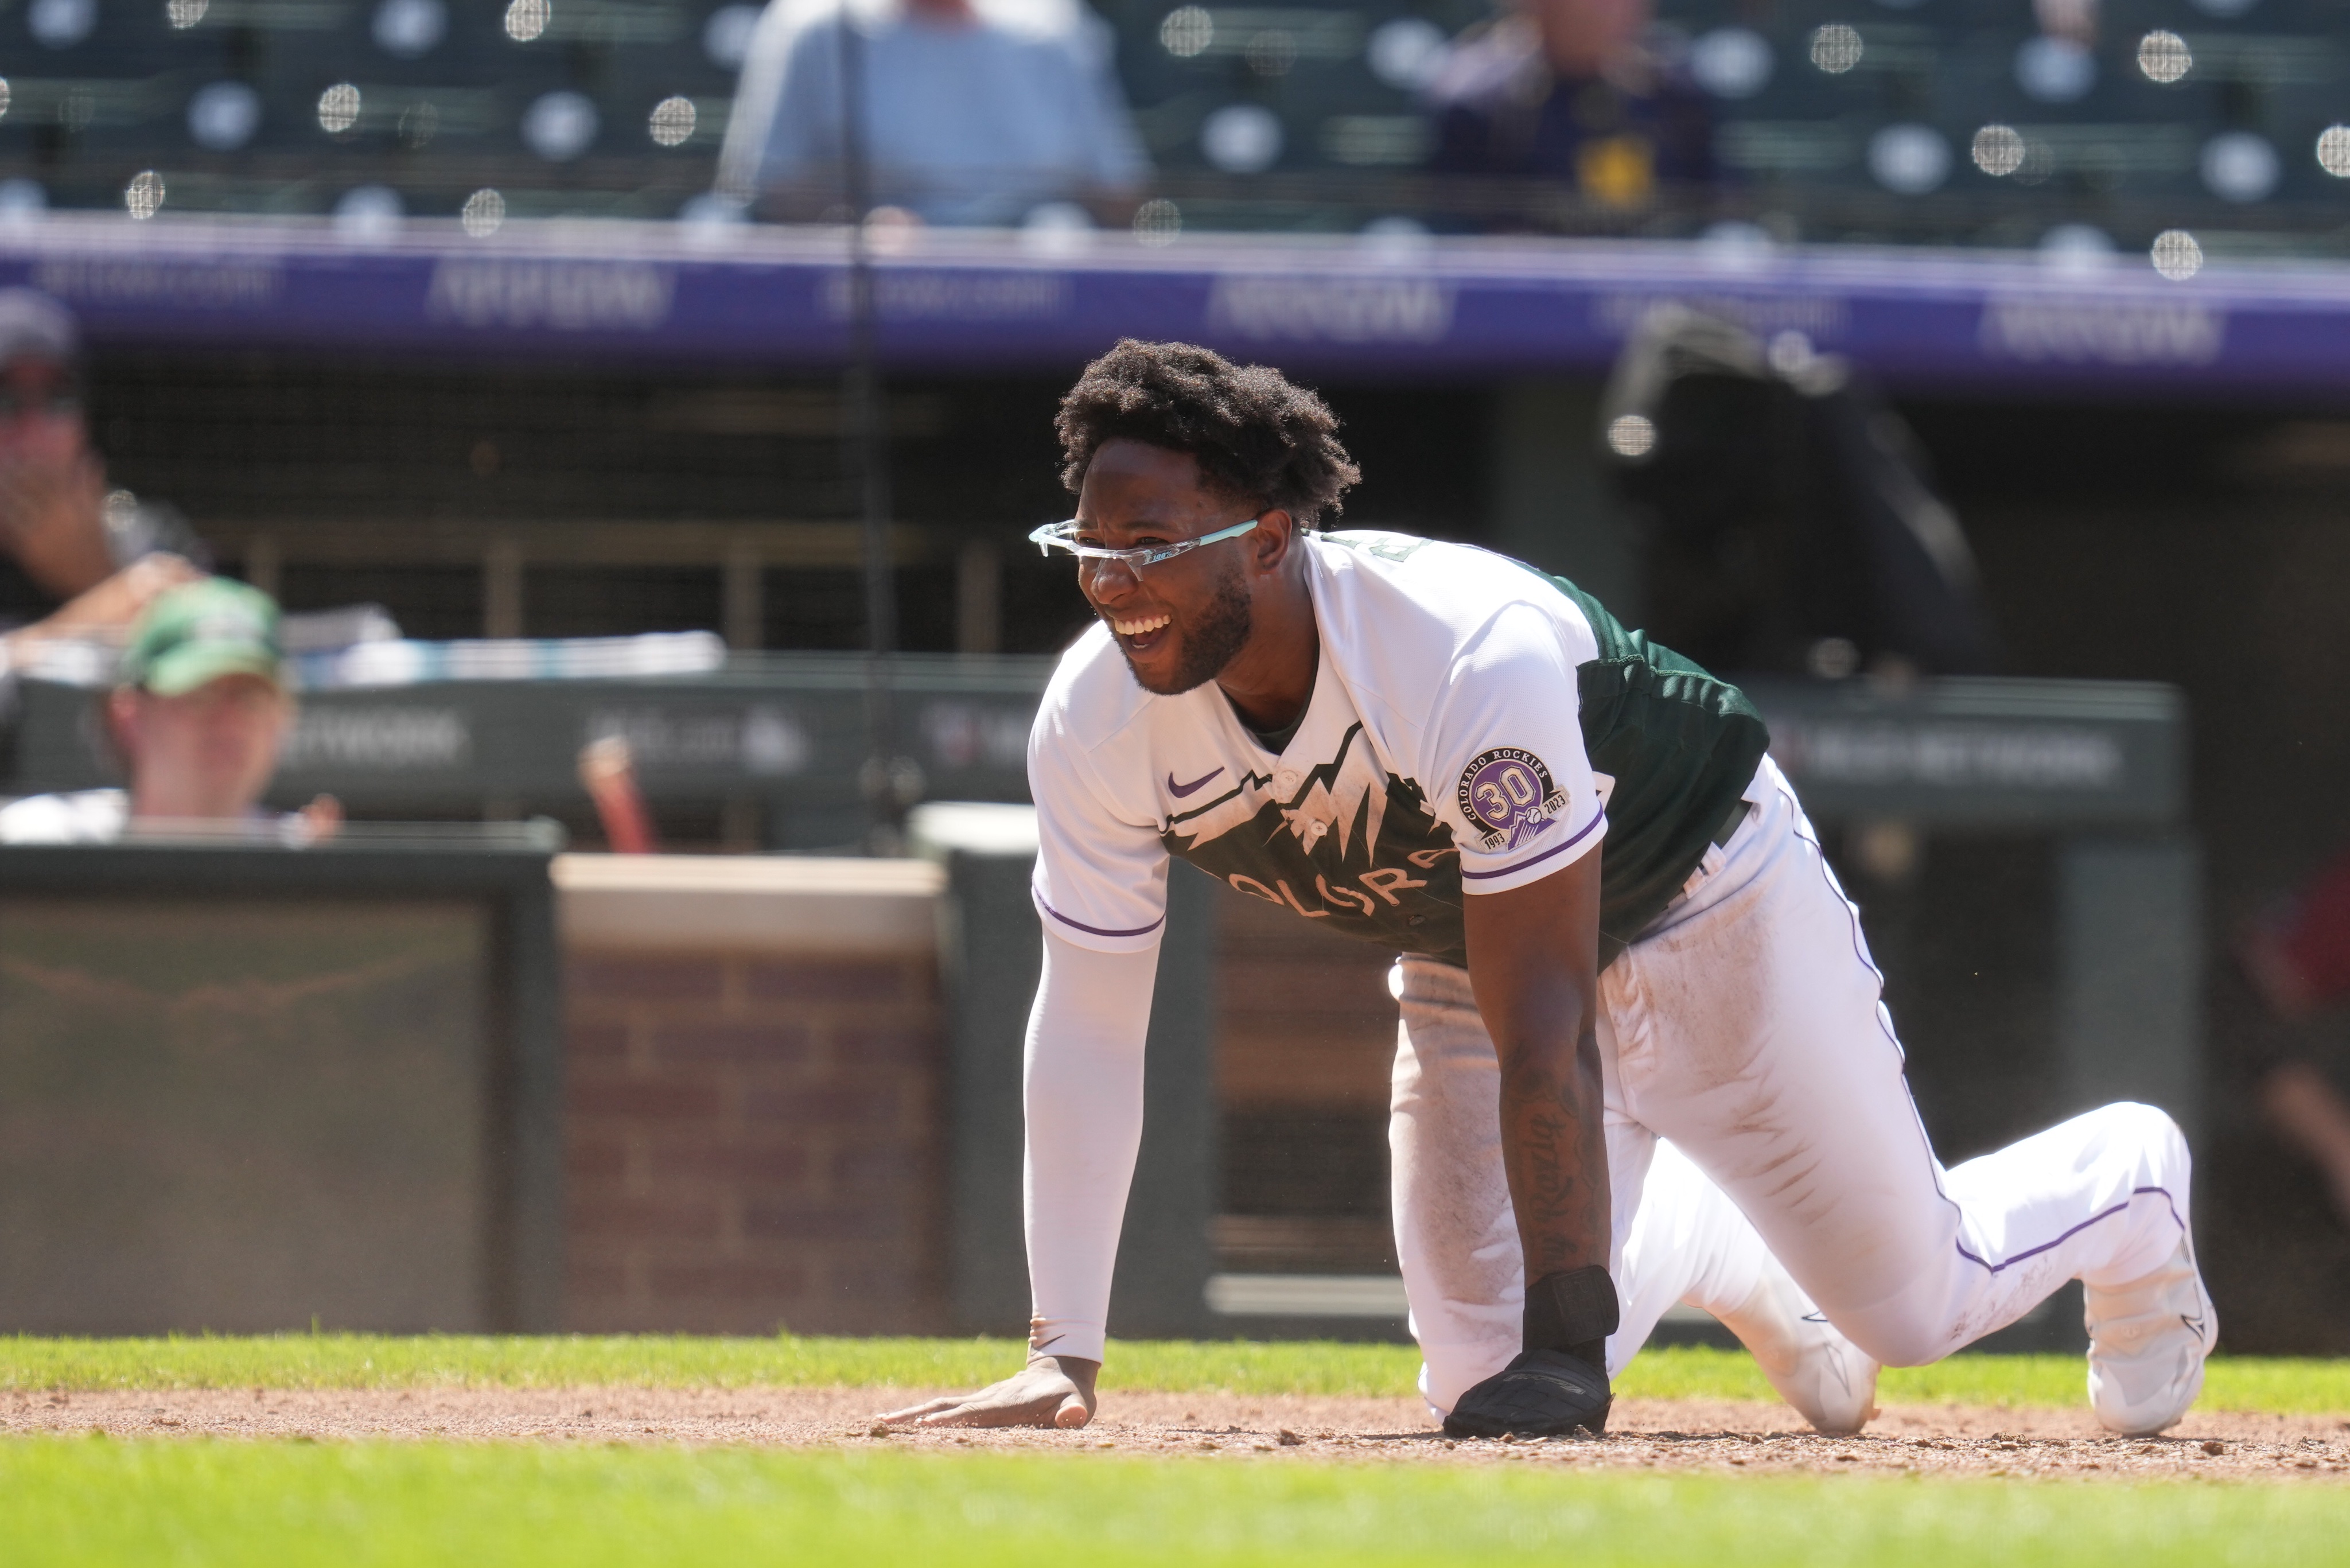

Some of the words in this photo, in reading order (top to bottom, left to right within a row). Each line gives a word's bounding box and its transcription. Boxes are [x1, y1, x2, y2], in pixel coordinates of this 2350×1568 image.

[1153, 550, 1173, 561] 100%
[1459, 757, 1487, 820] COLORADO
[1492, 750, 1547, 777] ROCKIES
[1474, 765, 1536, 821] 30
[1544, 795, 1566, 814] 2023
[1485, 832, 1505, 850] 1993
[1189, 846, 1462, 918] OLORA
